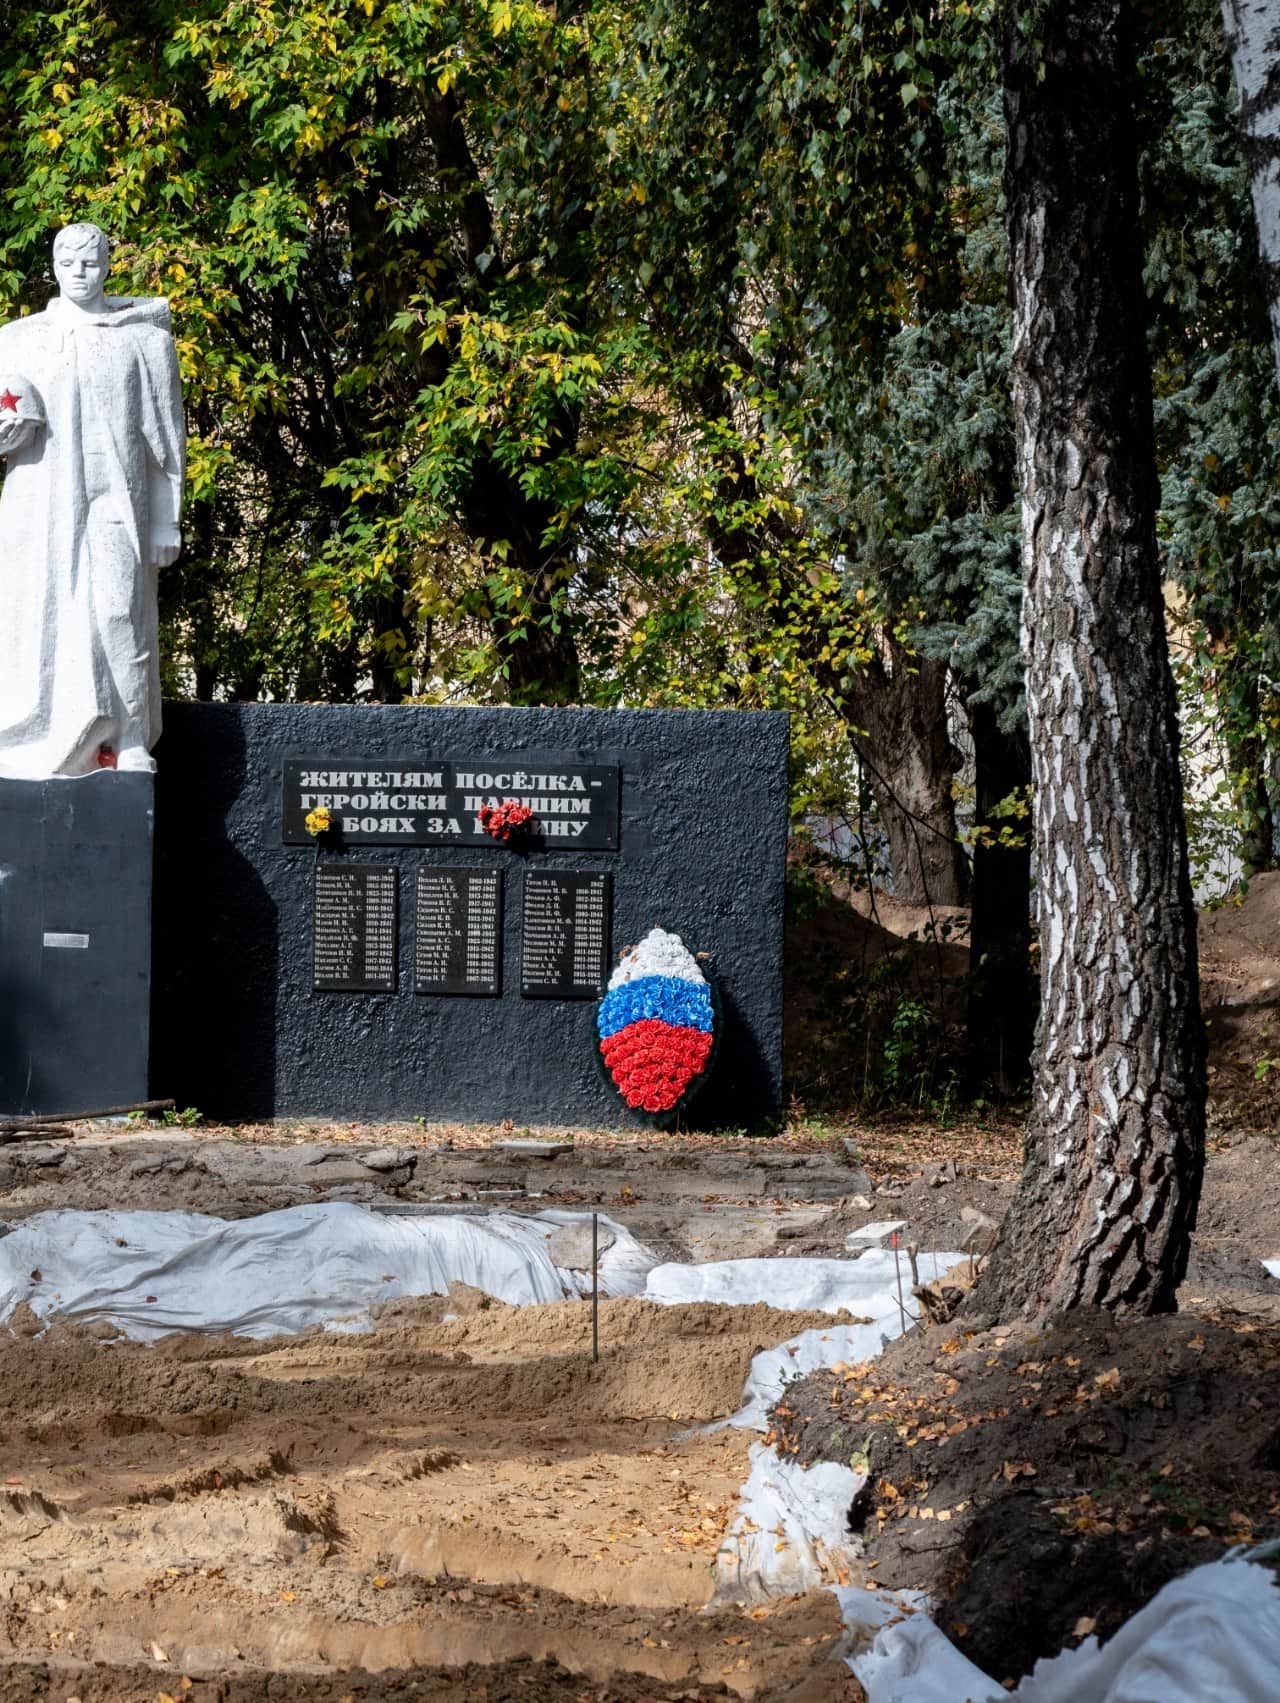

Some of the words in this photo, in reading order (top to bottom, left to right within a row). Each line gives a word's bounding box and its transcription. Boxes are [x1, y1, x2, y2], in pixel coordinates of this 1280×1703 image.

[299, 771, 443, 788] ЖИТЕЛЯМ
[455, 771, 587, 791] ПОСЁЛКА
[300, 791, 448, 810] ГЕРОЙСКИ
[342, 817, 416, 833] БОЯХ
[427, 817, 462, 834] ЗА
